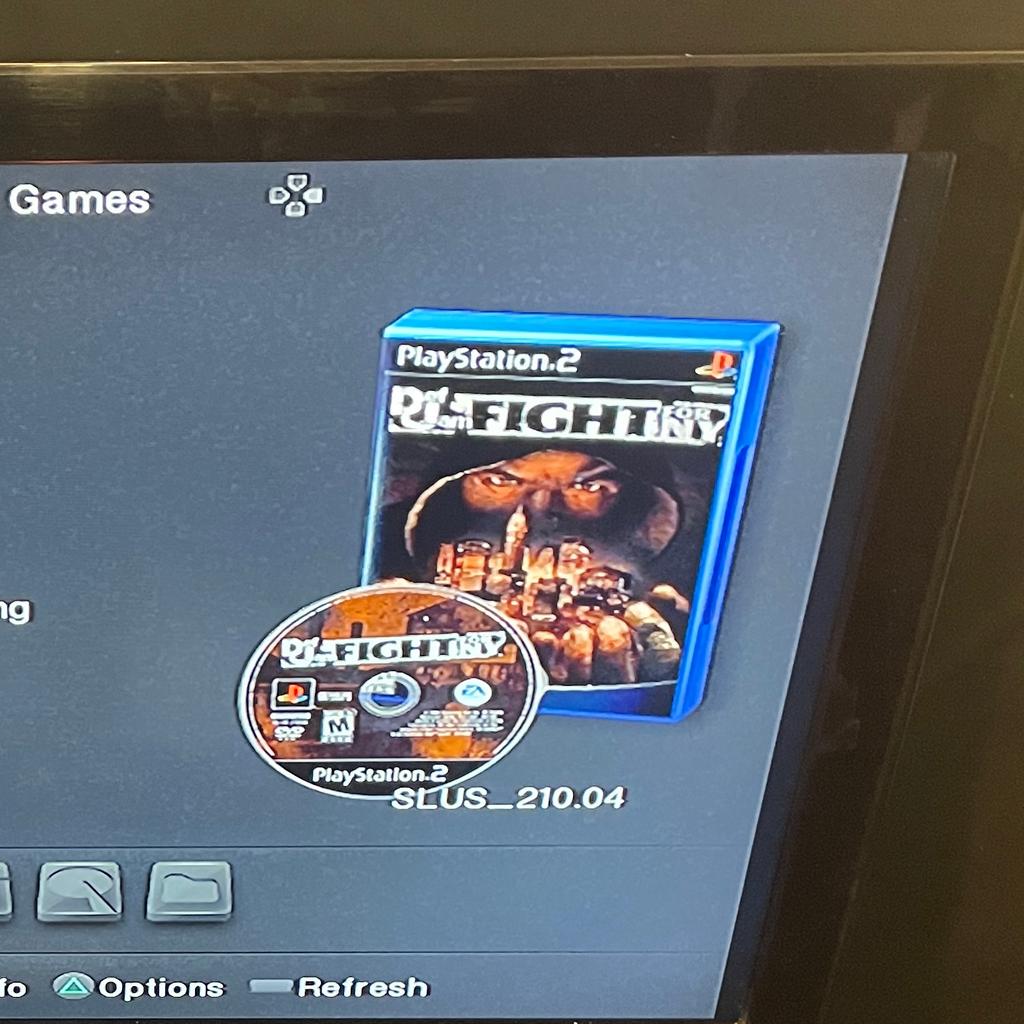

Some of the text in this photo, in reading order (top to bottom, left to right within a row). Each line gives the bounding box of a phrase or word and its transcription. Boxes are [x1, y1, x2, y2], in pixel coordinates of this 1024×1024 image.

[9, 183, 150, 216] Games
[473, 400, 654, 439] FIGHT
[391, 785, 626, 810] SLUS_210.04
[98, 977, 224, 1002] Options
[298, 976, 428, 998] Refresh
